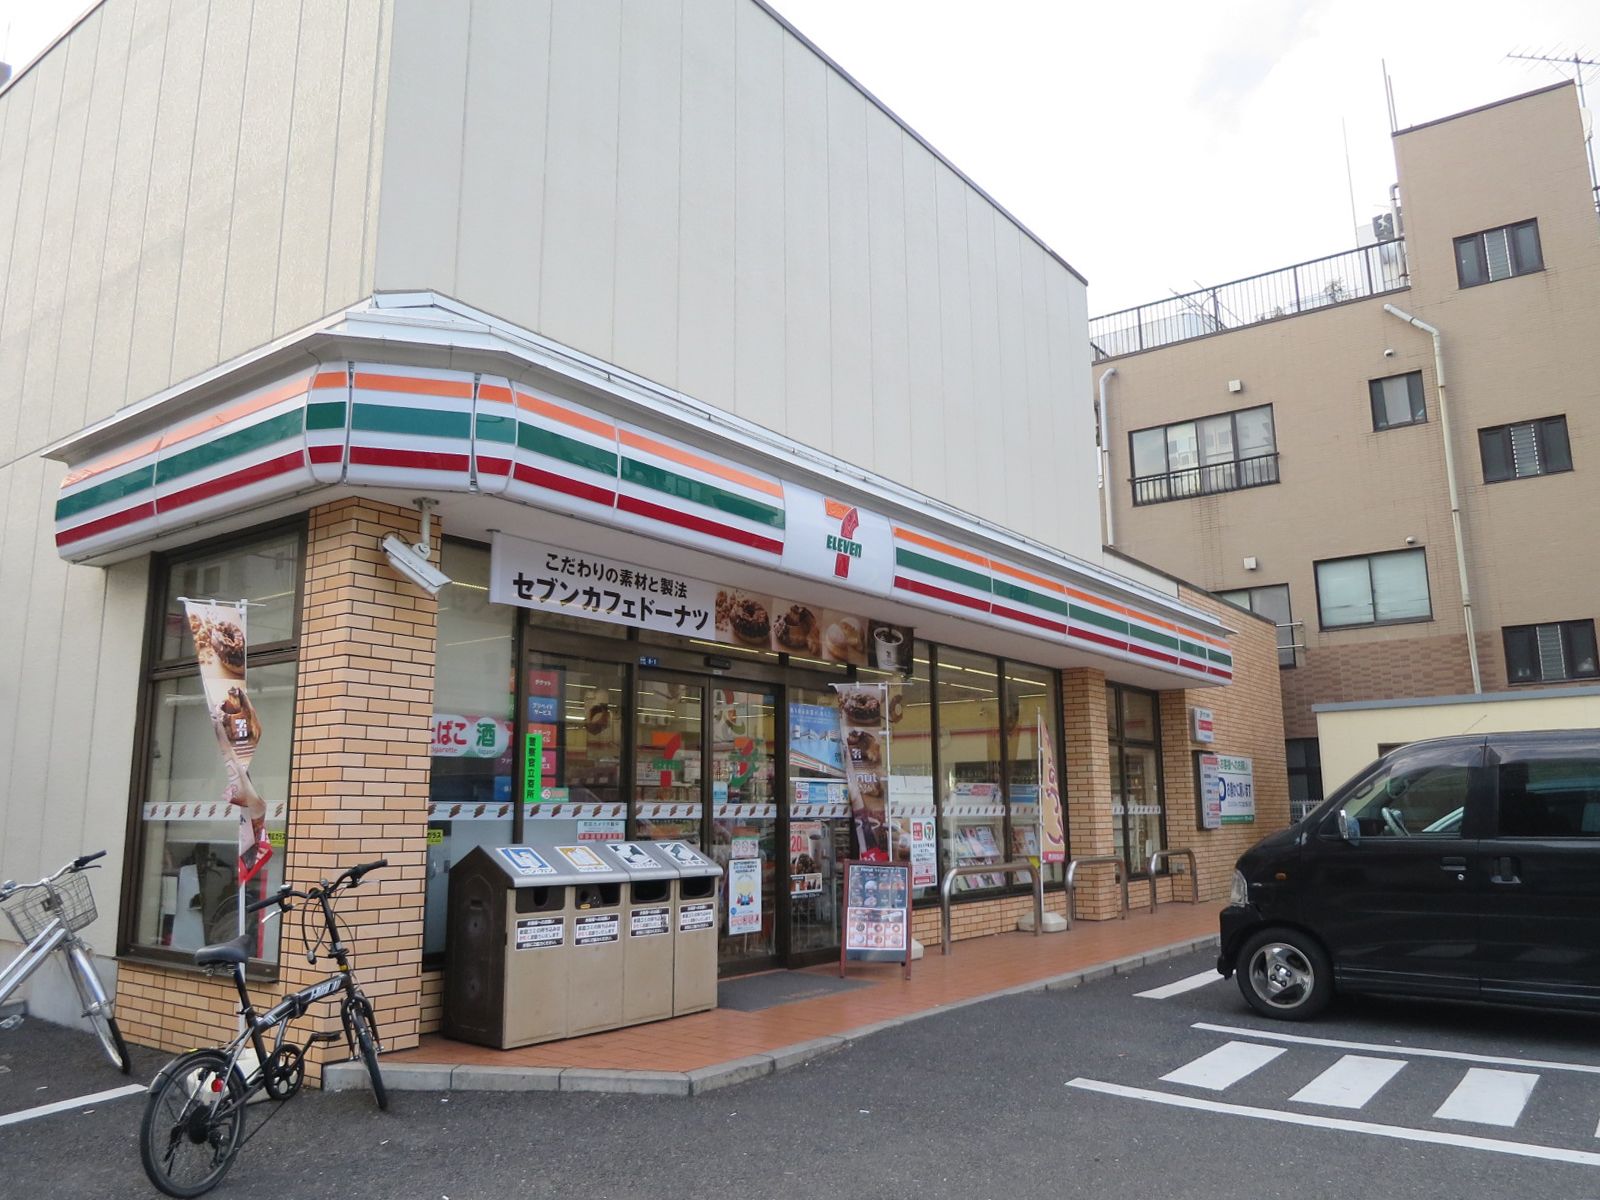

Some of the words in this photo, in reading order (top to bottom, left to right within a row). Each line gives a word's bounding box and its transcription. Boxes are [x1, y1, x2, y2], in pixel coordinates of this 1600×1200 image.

[513, 573, 709, 631] セブンカフェドーナツ
[546, 553, 688, 599] こだわりの素材と製法
[476, 723, 496, 747] 酒
[526, 737, 536, 798] 警察官立寄所
